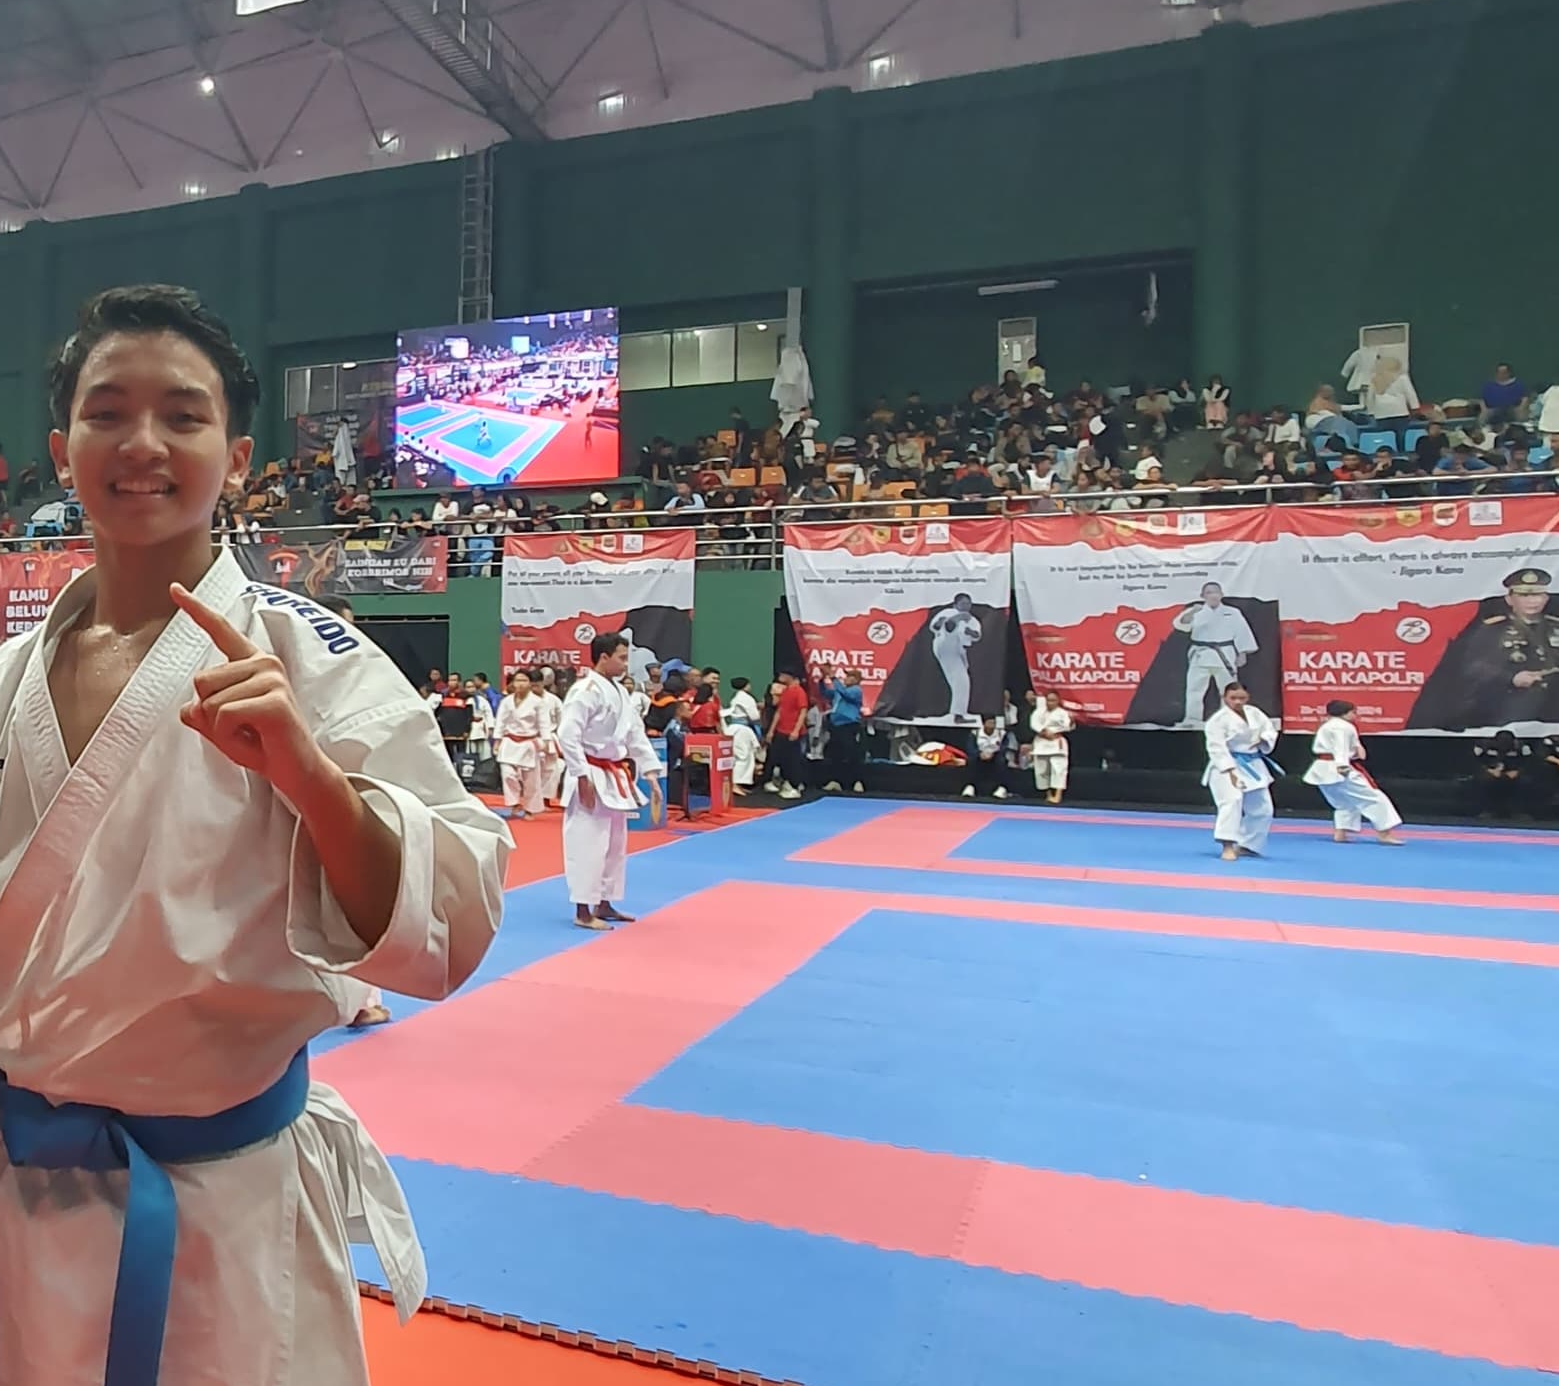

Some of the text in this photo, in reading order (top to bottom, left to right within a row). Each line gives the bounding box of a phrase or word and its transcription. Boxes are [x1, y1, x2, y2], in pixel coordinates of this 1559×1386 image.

[8, 588, 49, 603] KAMU
[514, 649, 581, 665] KARATE
[806, 649, 875, 666] ARATE
[1036, 652, 1126, 669] KARATE
[1299, 651, 1407, 669] KARATE
[1069, 670, 1141, 683] KAPOLRI
[1284, 671, 1425, 684] PIALA KAPOLRI
